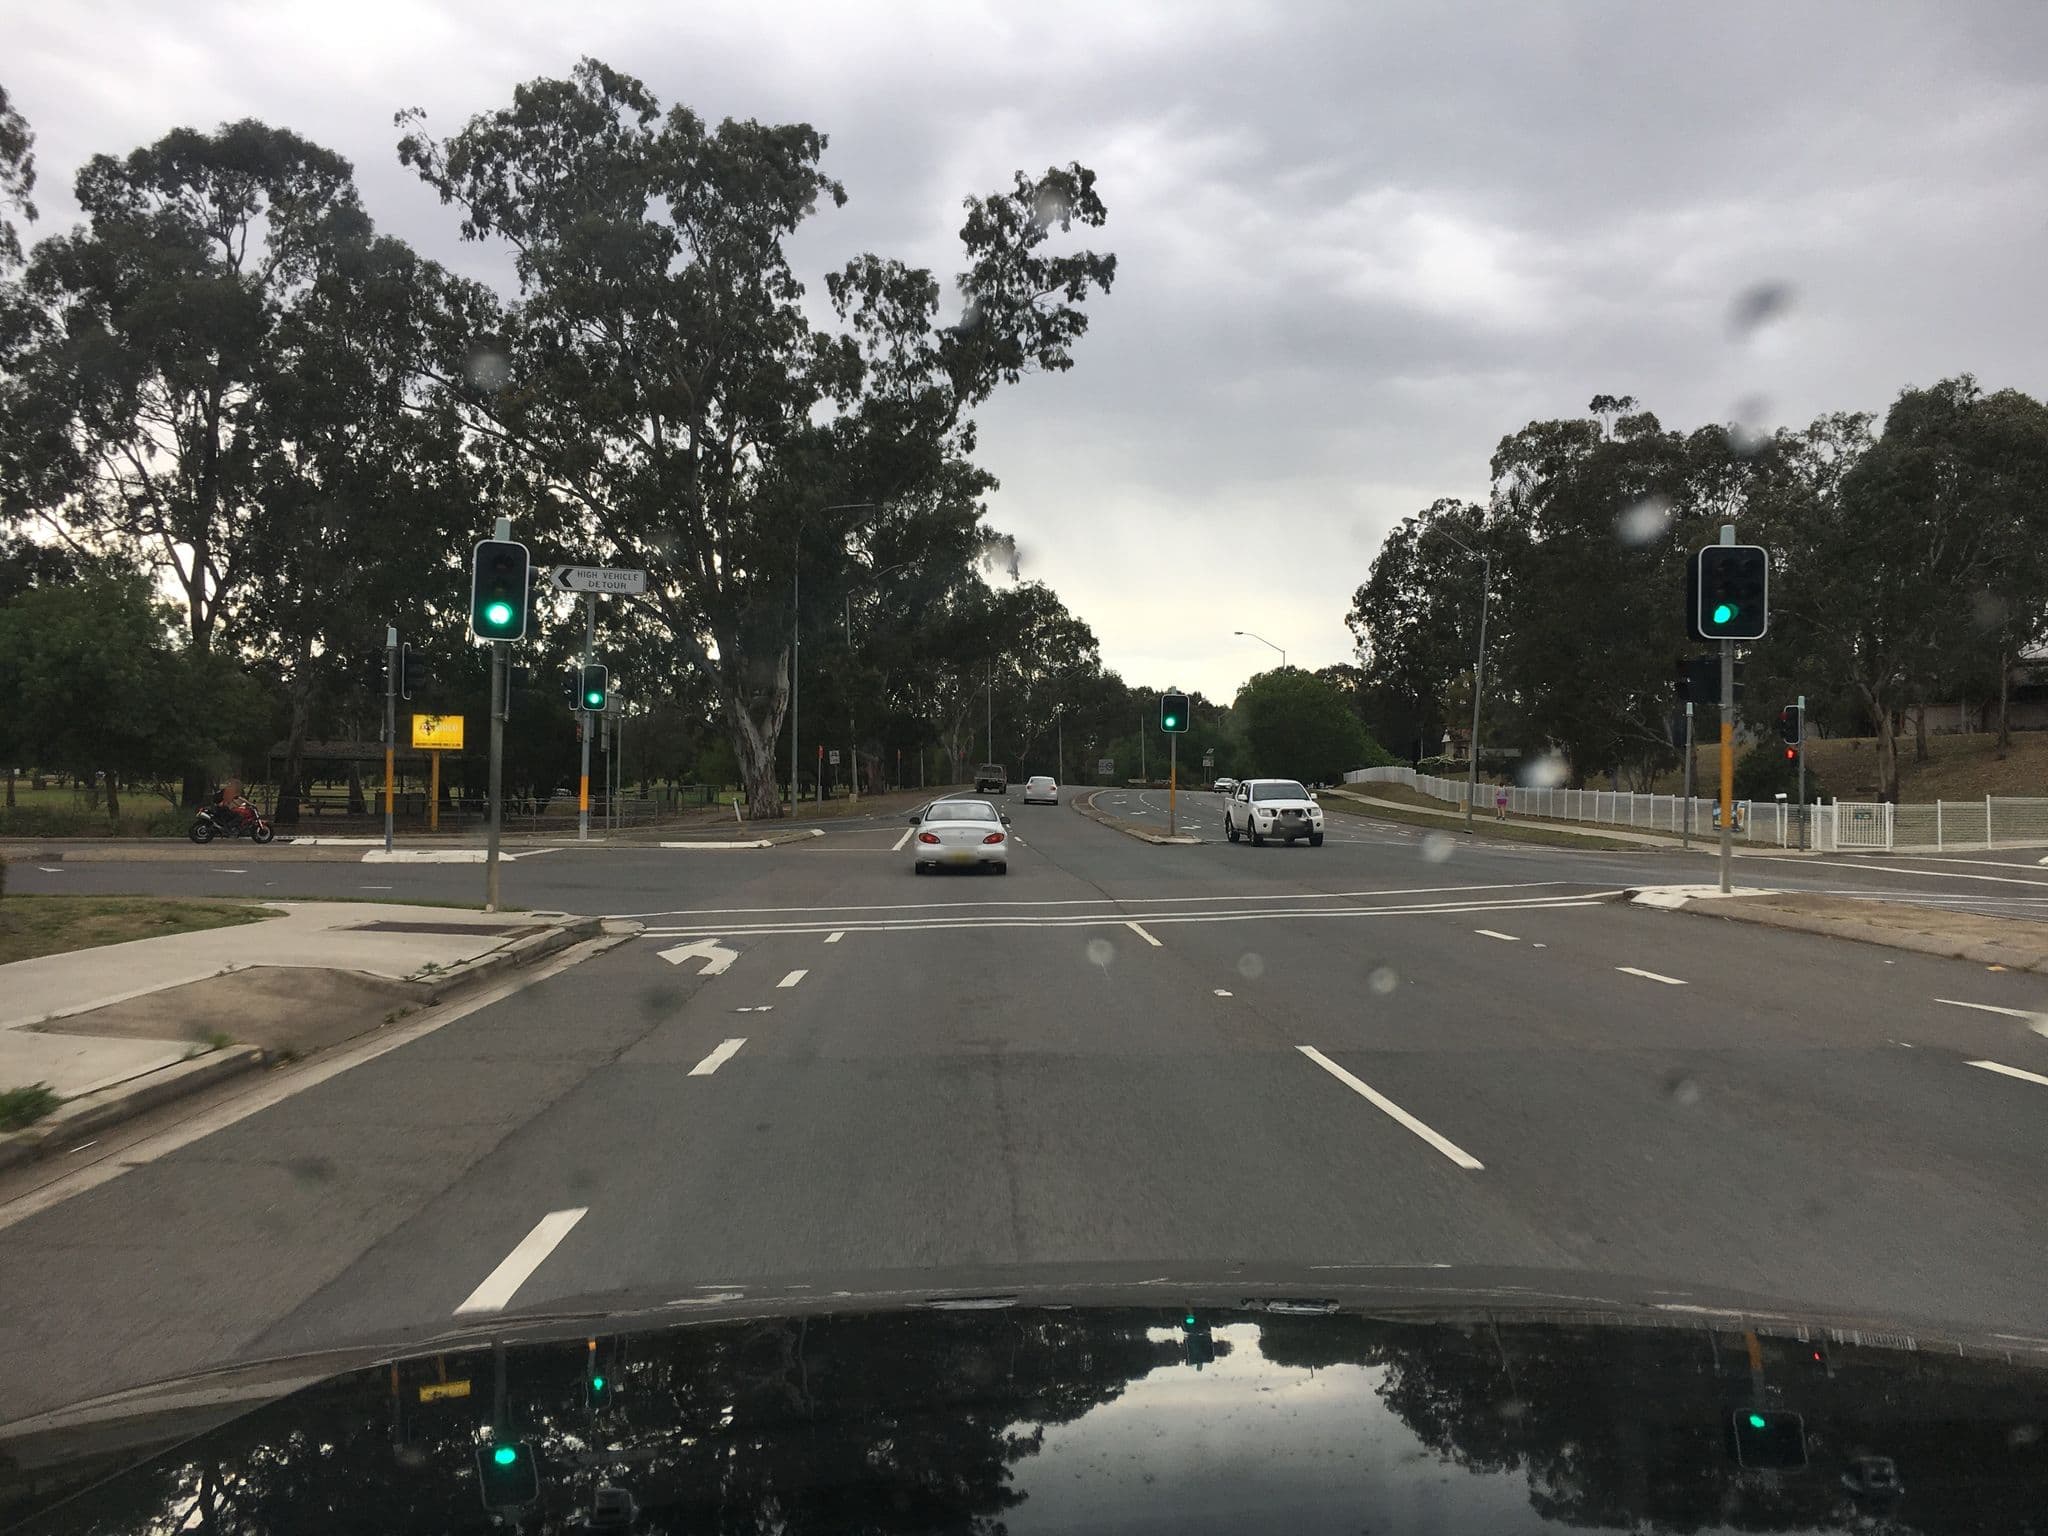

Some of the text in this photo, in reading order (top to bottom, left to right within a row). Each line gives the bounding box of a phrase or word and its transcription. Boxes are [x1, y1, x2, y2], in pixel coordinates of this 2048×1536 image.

[577, 570, 639, 581] HIGH VEHICLE
[588, 580, 627, 589] DETOUR
